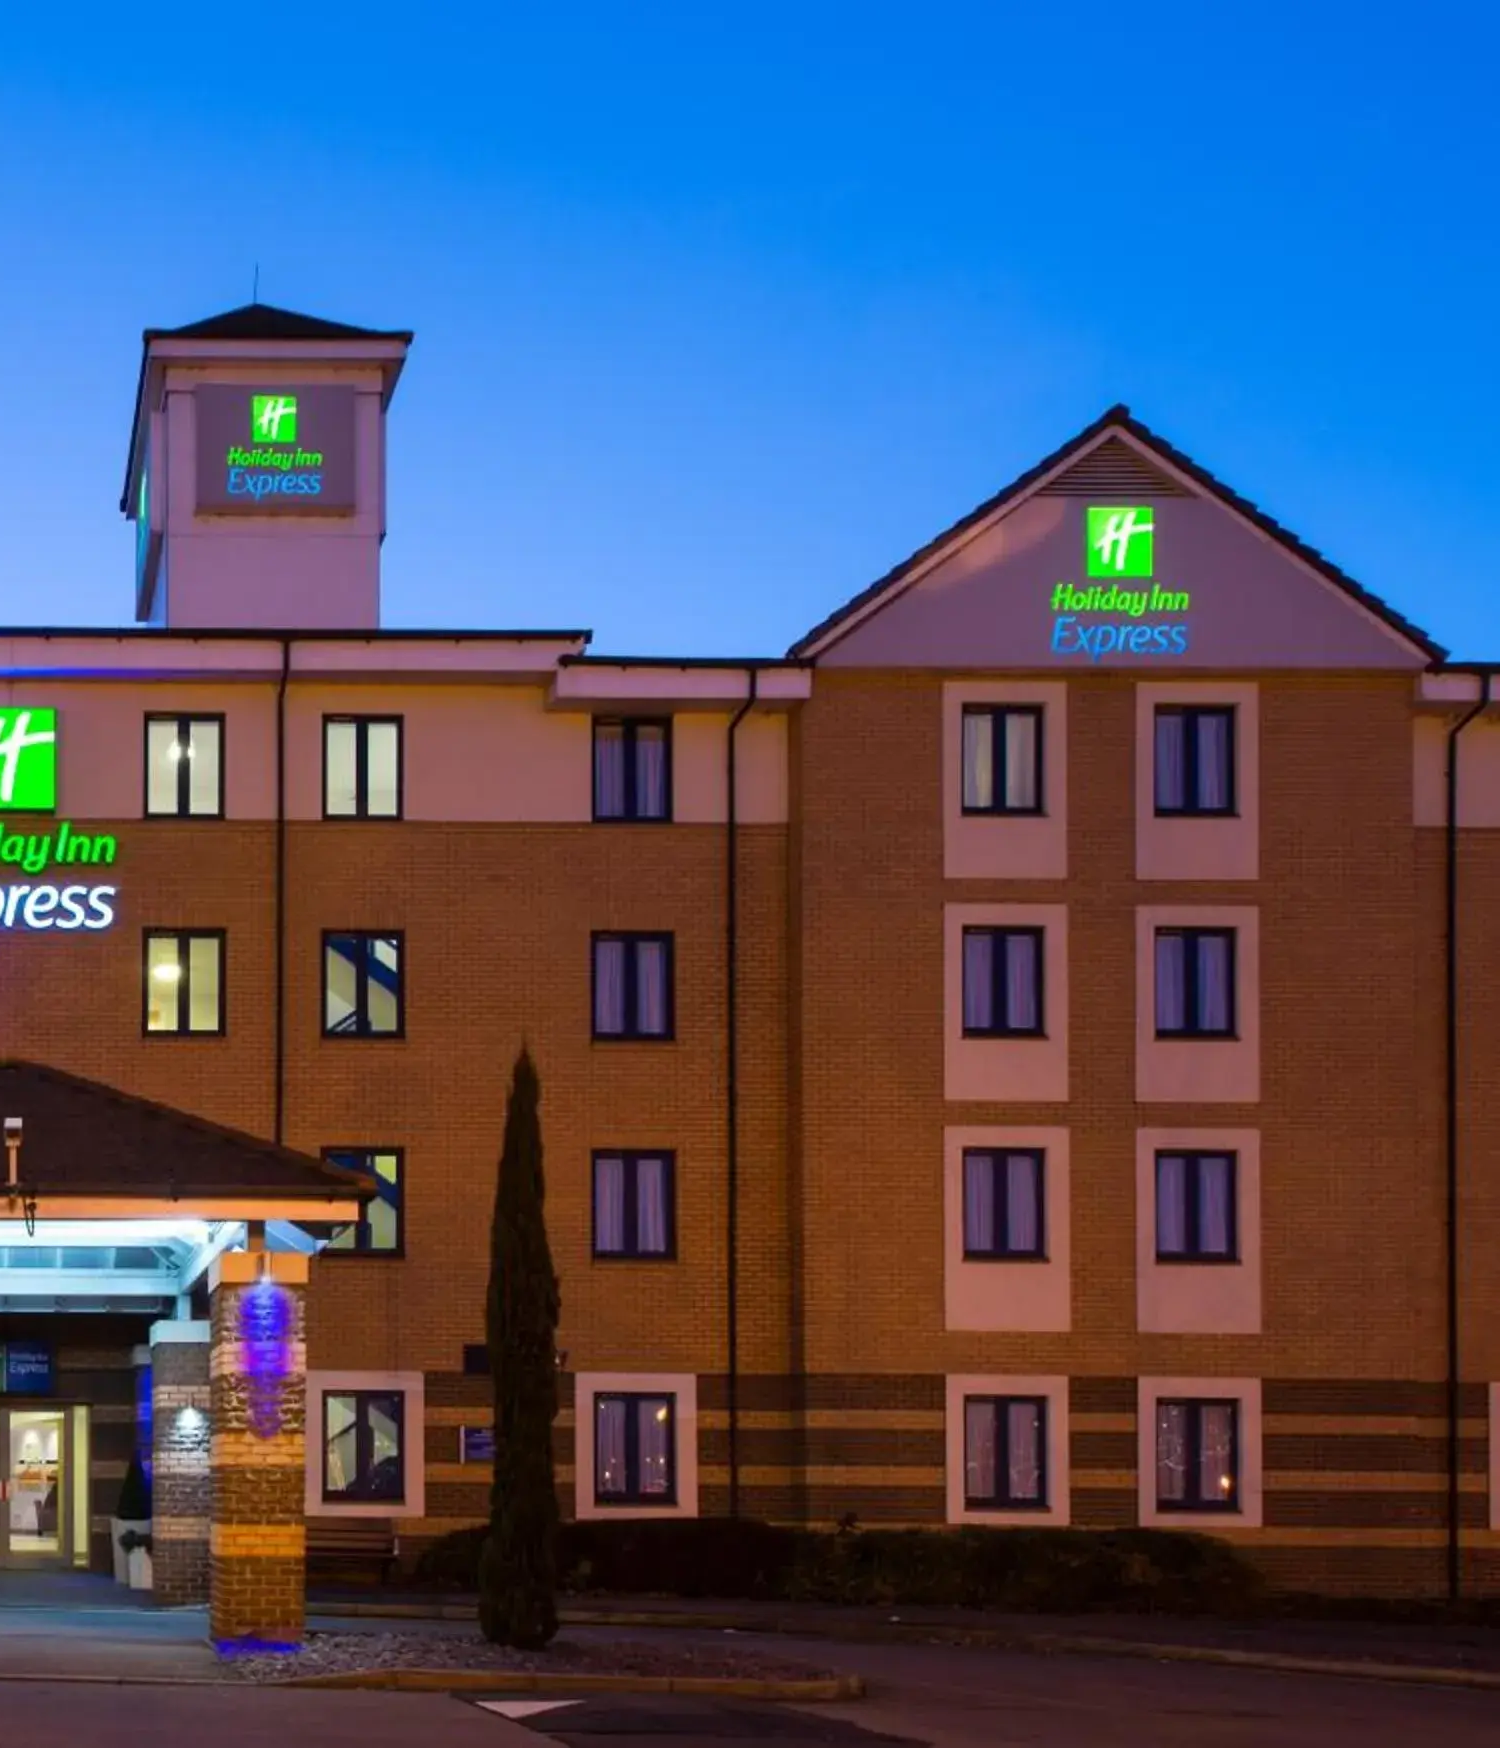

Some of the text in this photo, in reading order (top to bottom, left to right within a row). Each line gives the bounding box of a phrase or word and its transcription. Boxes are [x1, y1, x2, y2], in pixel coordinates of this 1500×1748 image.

[228, 447, 323, 471] Holiday Inn
[227, 468, 322, 499] Express
[1052, 582, 1189, 617] Holiday Inn
[1052, 616, 1188, 662] Express
[55, 820, 116, 863] Inn
